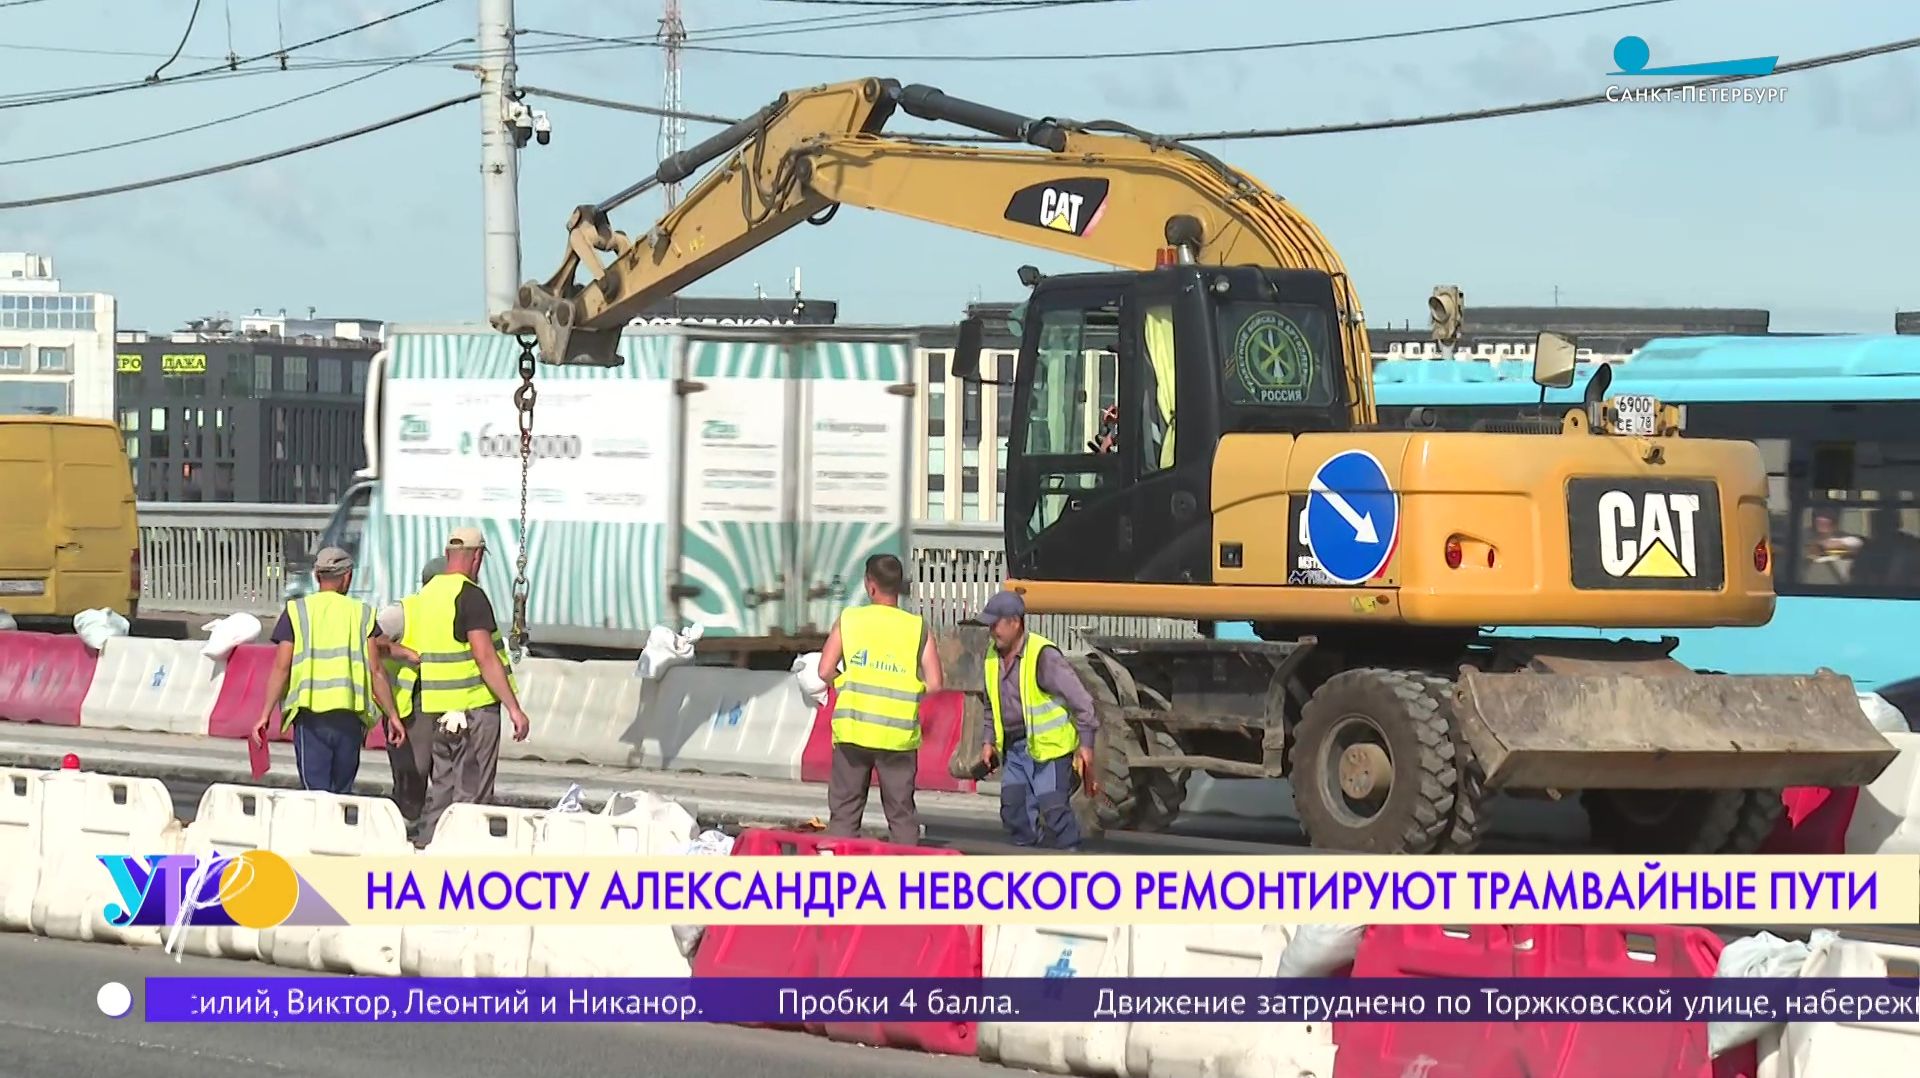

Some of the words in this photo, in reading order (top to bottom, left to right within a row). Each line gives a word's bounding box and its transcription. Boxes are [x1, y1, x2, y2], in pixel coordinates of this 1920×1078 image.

[1040, 187, 1084, 233] CAT
[117, 358, 142, 369] РО
[1260, 390, 1302, 401] РОССИЯ
[1619, 397, 1650, 413] 6900
[1599, 490, 1700, 577] CAT
